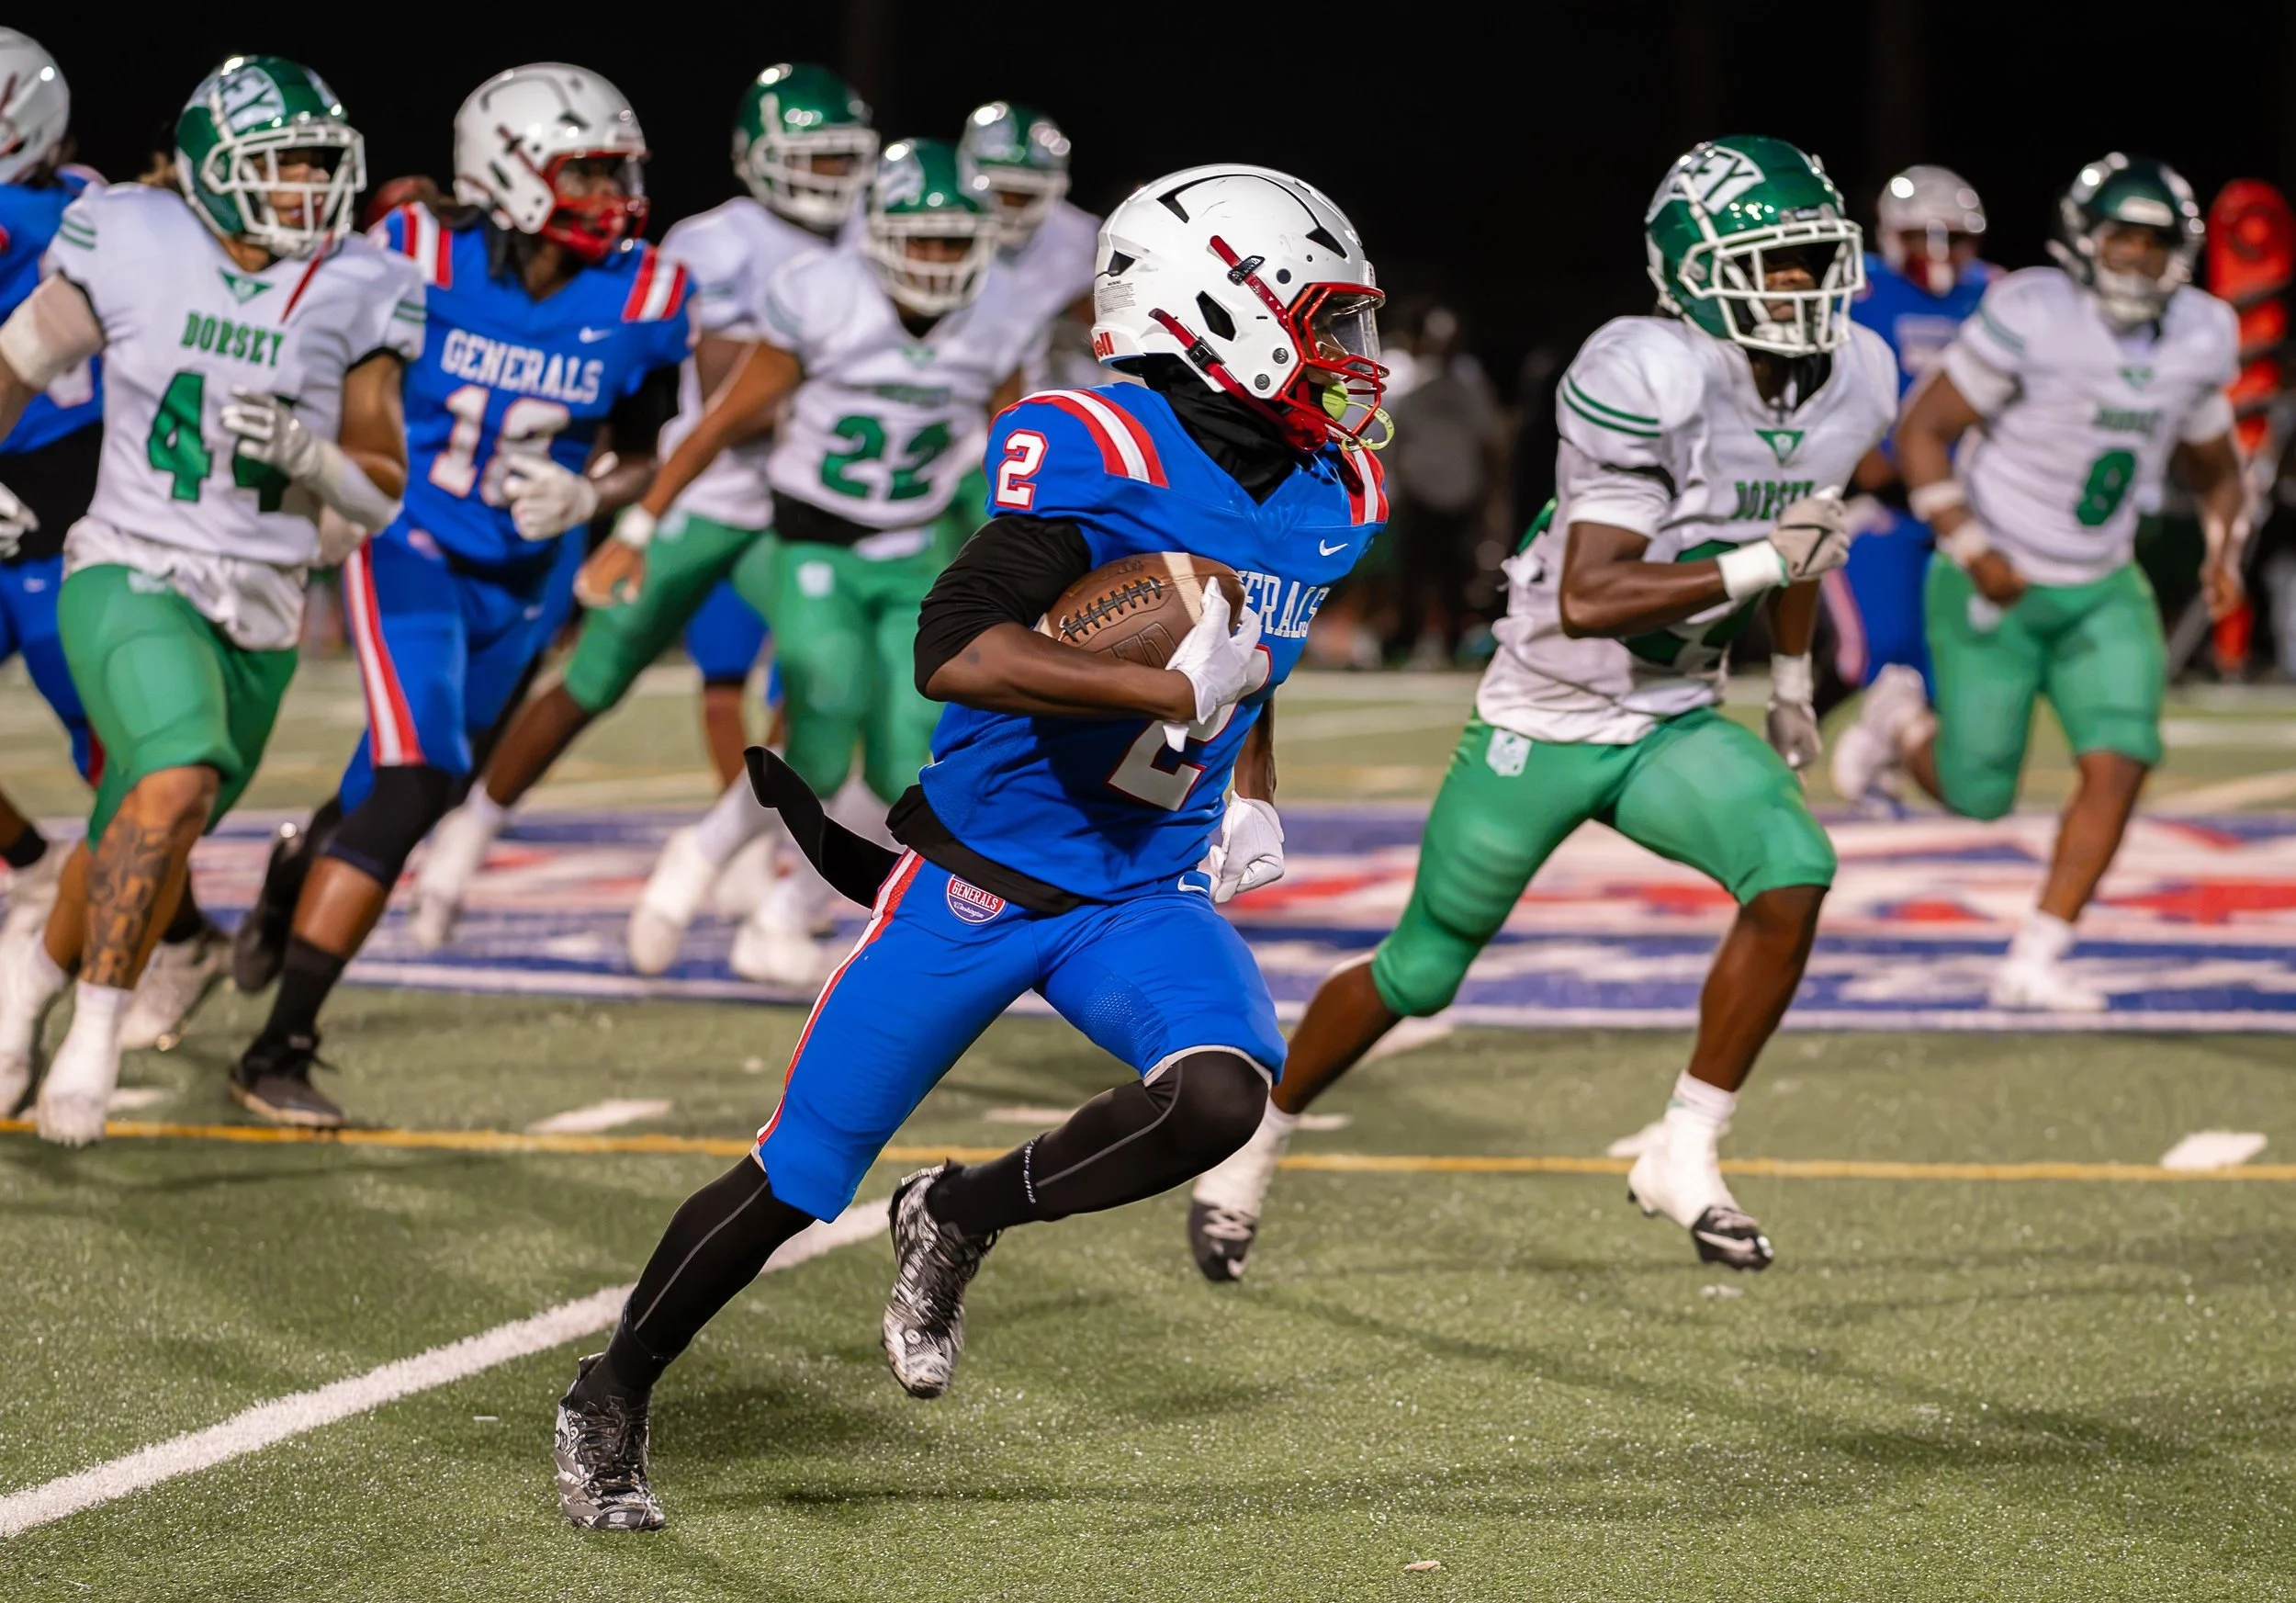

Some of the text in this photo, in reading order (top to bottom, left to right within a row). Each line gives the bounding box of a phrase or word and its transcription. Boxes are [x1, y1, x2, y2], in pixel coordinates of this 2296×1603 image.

[181, 310, 285, 367] DORSEY
[441, 328, 604, 404] GENERALS
[821, 415, 951, 501] 22
[996, 428, 1050, 511] 2
[951, 882, 998, 910] GENERALS
